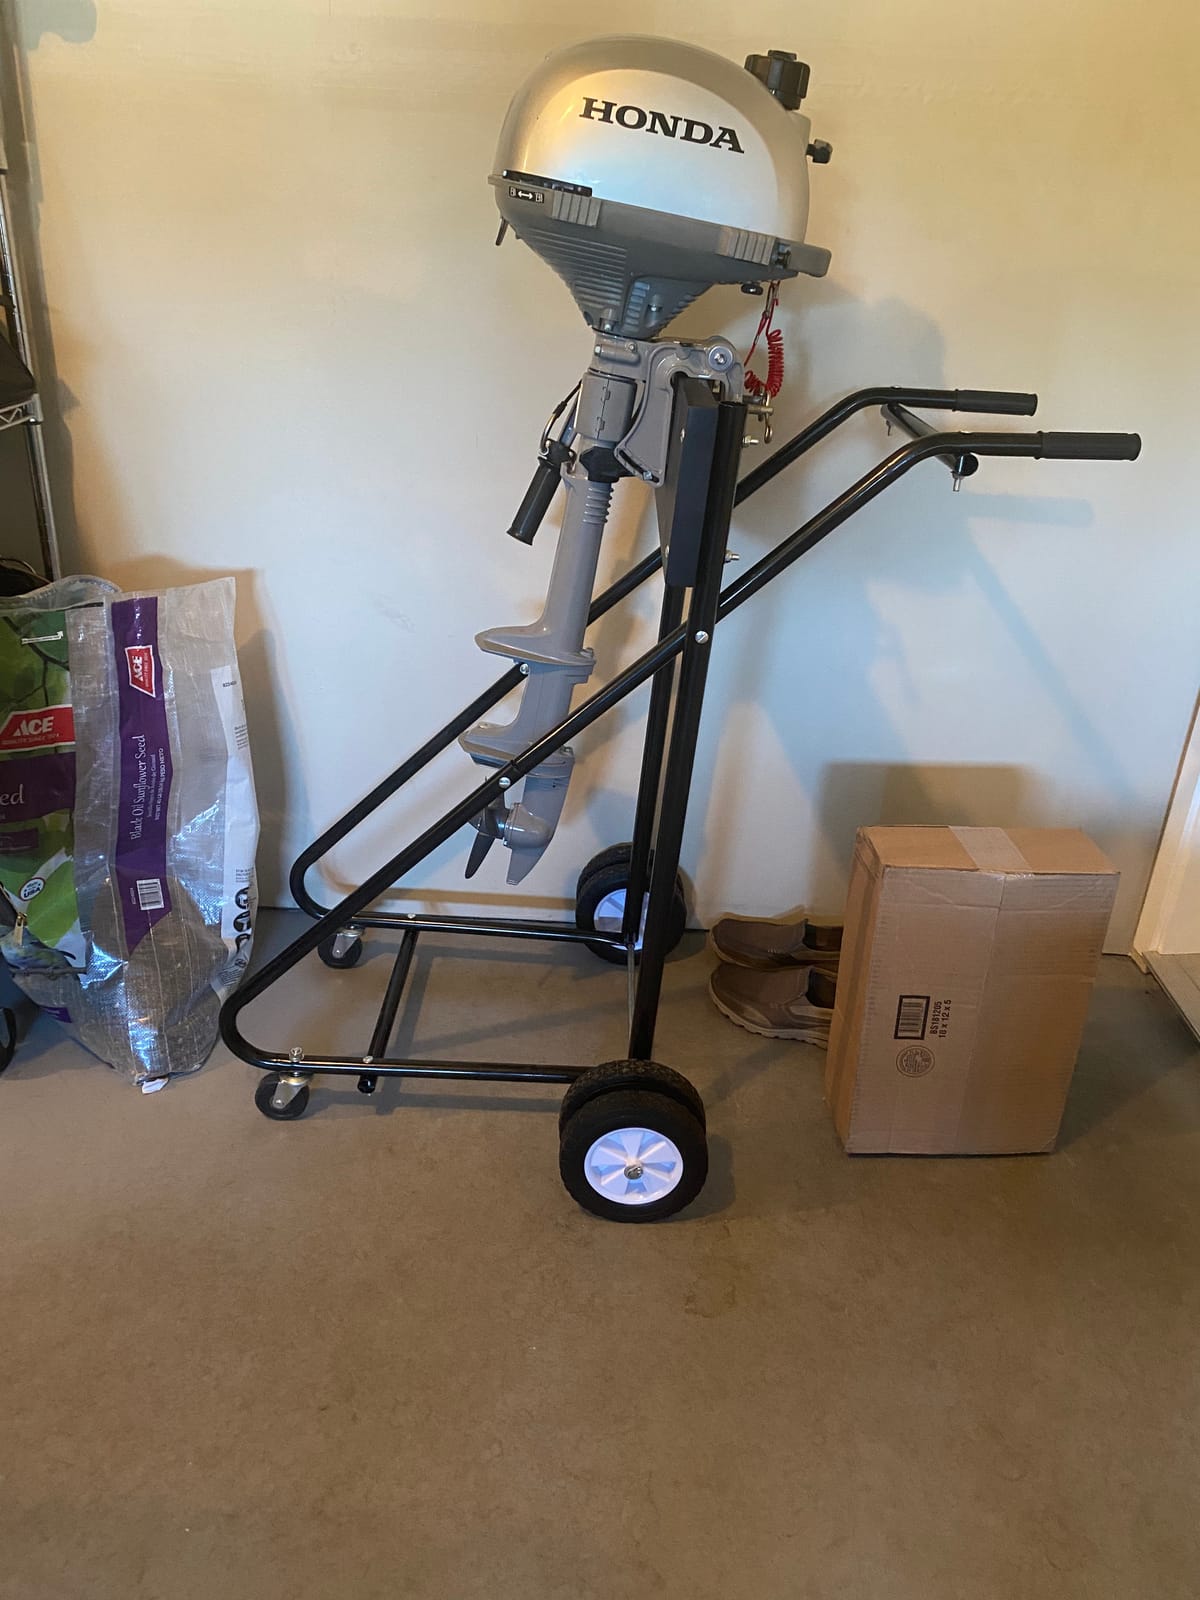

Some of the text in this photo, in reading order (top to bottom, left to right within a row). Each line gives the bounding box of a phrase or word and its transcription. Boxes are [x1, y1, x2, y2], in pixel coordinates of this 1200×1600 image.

[579, 97, 745, 154] HONDA
[132, 655, 144, 682] ACE
[13, 716, 54, 737] ACE
[129, 734, 150, 840] Black Oil Sunflower Seed
[24, 886, 41, 898] USA
[941, 1011, 950, 1021] 12
